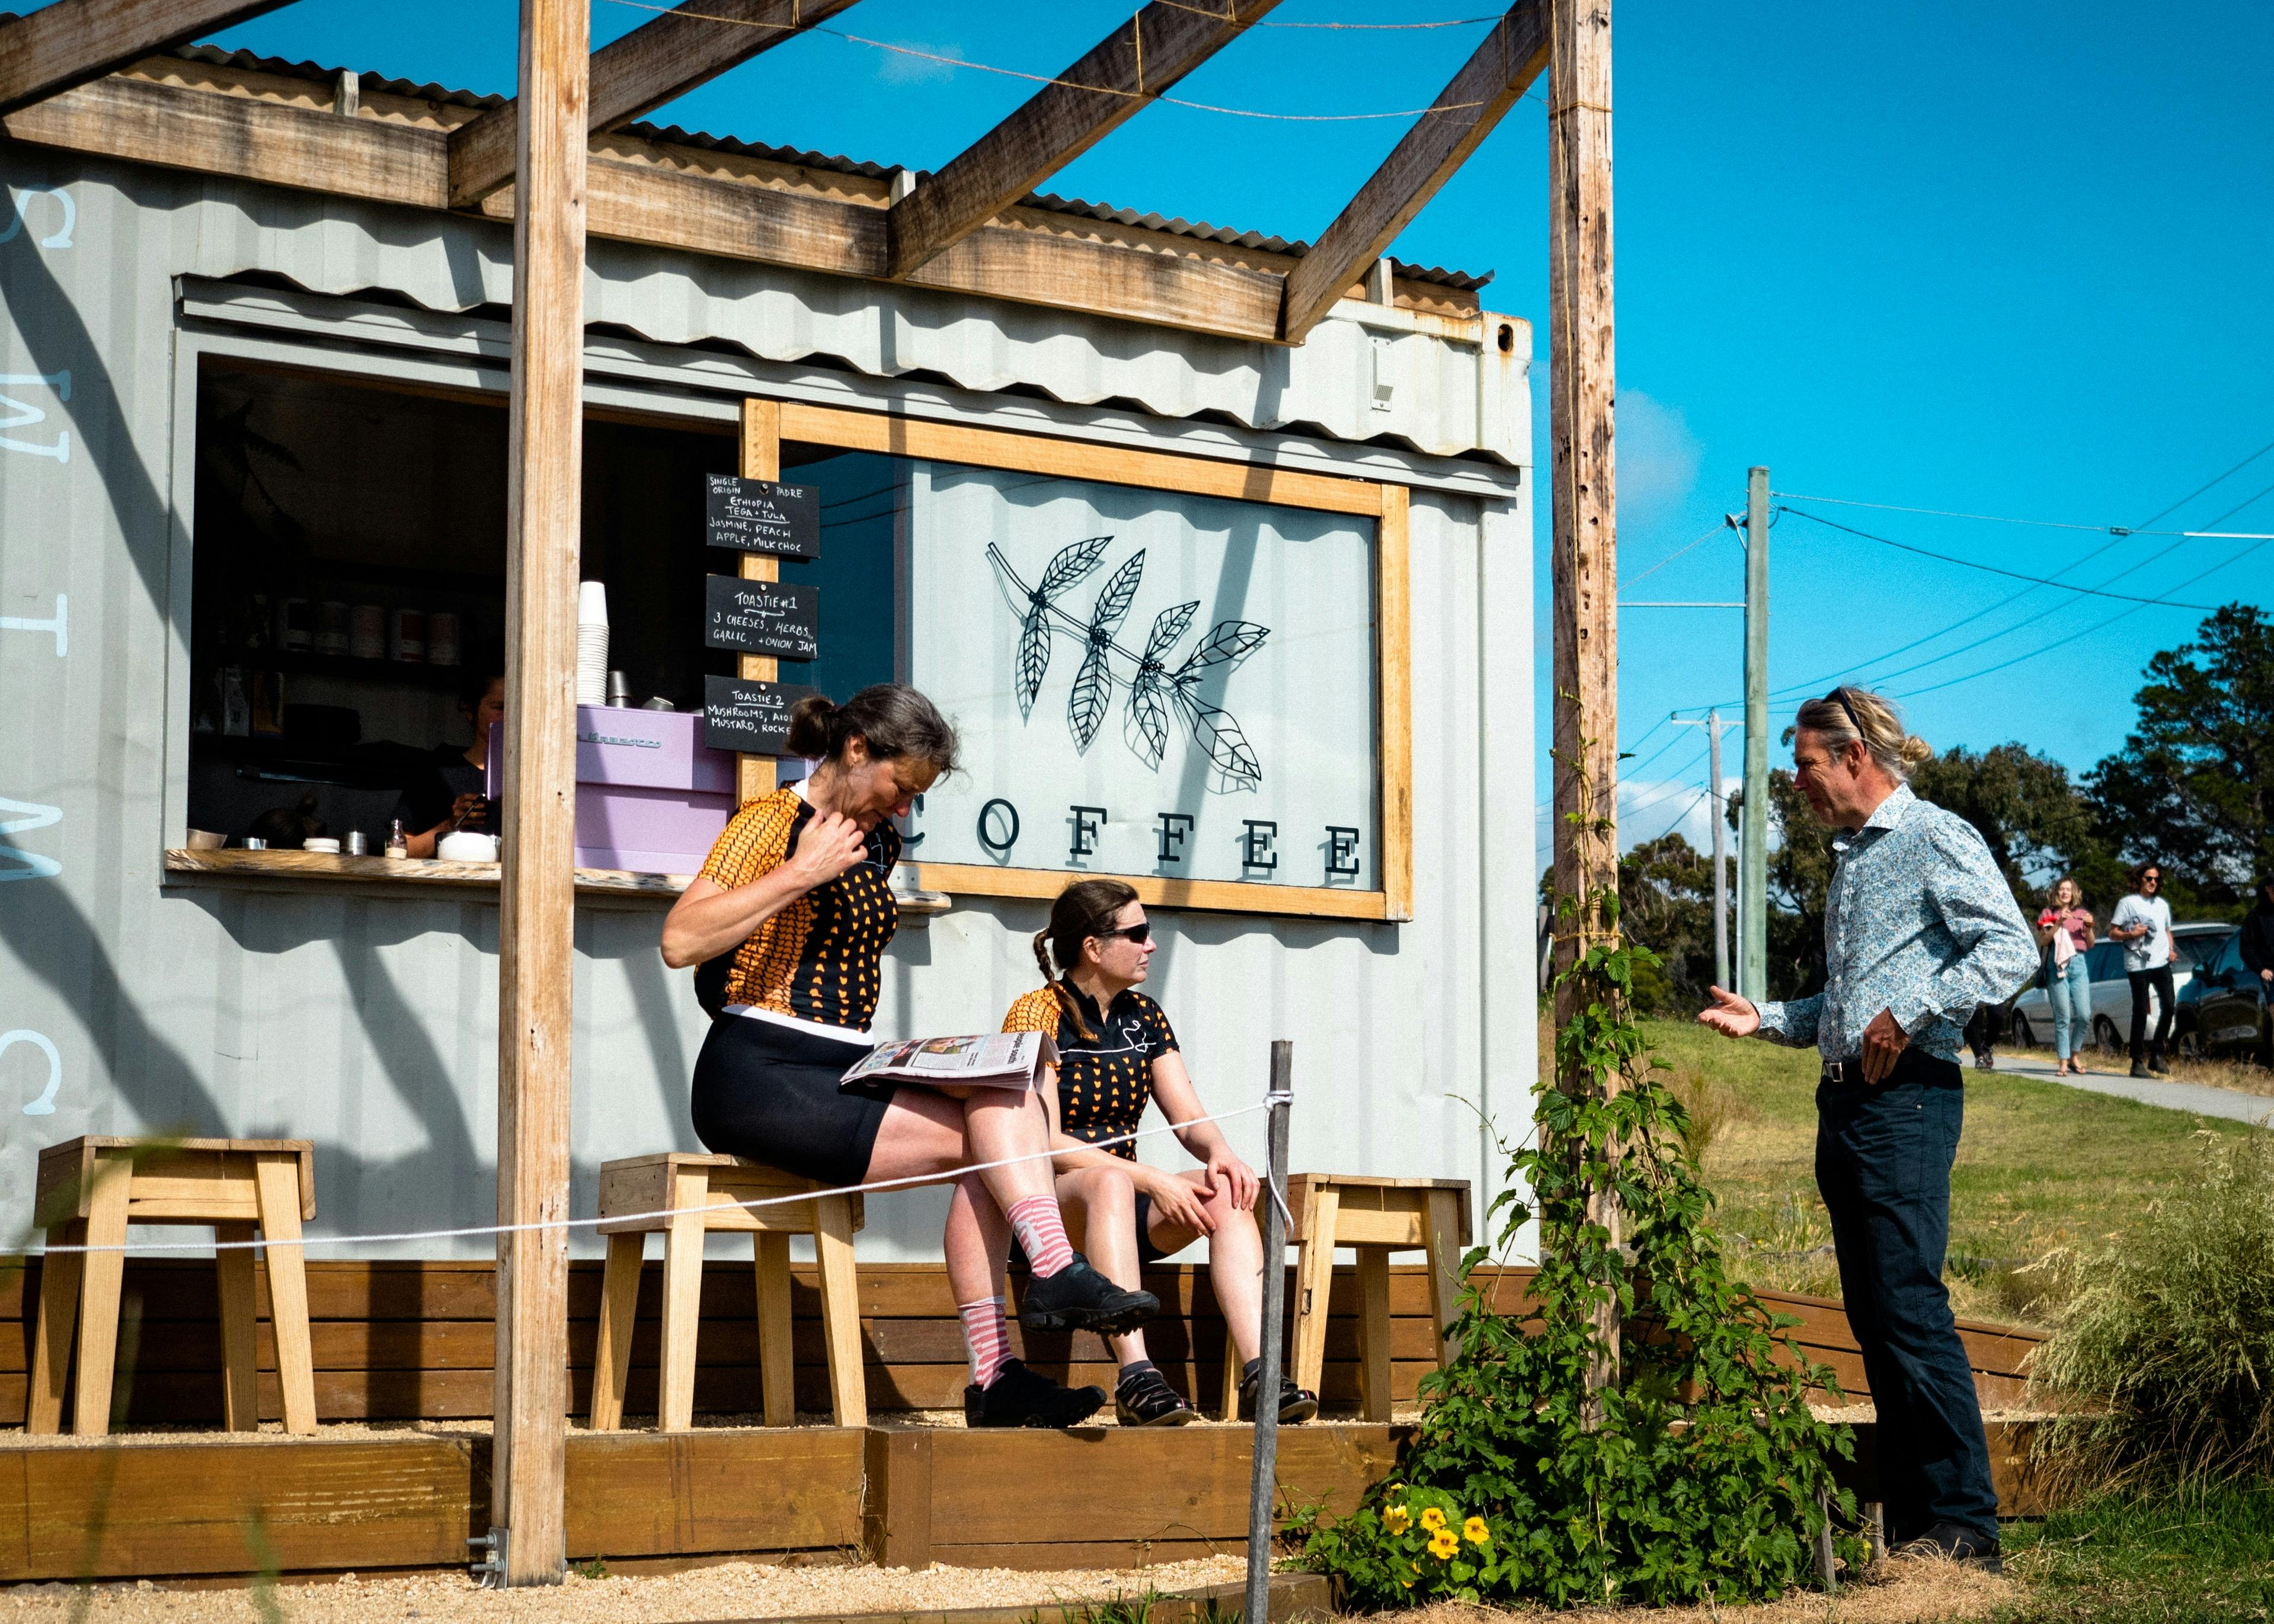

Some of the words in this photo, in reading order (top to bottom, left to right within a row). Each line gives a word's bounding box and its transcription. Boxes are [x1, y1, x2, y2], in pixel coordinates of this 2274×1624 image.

[710, 477, 738, 486] SINGLE
[776, 486, 803, 498] PADRE
[730, 497, 775, 510] ETHIOPIA
[725, 505, 753, 517] TEGA
[762, 510, 786, 522] TULA
[756, 524, 791, 538] PEACH
[717, 532, 750, 547] APPLE,
[754, 537, 776, 549] MILK
[778, 542, 801, 552] CHOC
[714, 612, 721, 623] 3
[727, 614, 769, 632] CHEESES,
[798, 640, 817, 659] JAM
[731, 690, 770, 704] TOASTIE
[776, 696, 785, 705] 2
[708, 704, 767, 723] MUSHROOMS,
[711, 717, 757, 733] MUSTARD,
